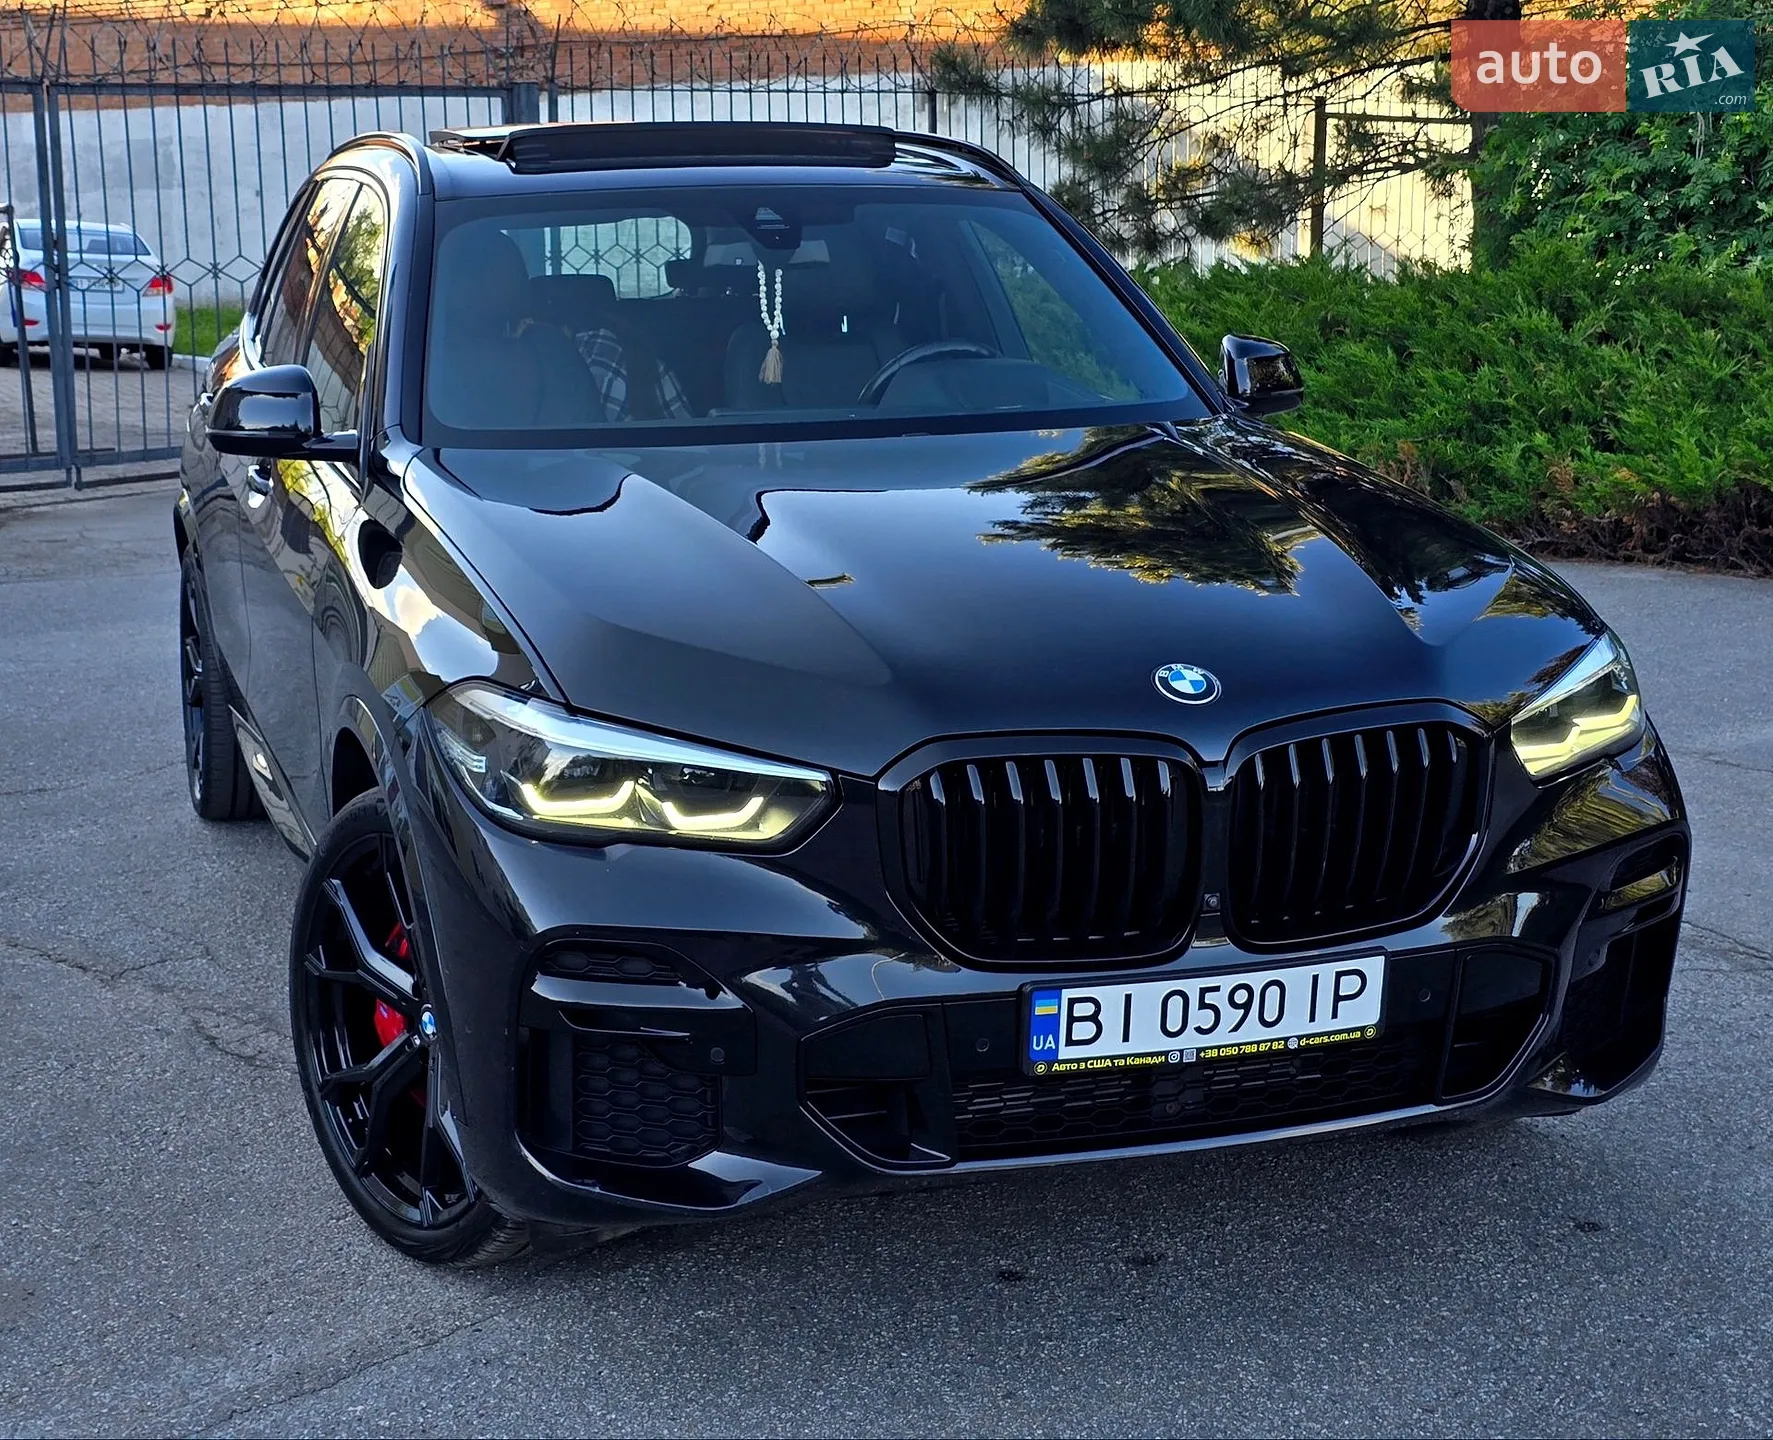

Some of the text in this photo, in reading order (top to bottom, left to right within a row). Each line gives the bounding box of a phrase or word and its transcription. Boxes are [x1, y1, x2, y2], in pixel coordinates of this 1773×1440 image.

[1065, 969, 1367, 1047] BI 0590 IP
[1033, 1034, 1056, 1050] UA
[1199, 1031, 1361, 1059] +38 050 788 87 82 d-cars.com.ua
[1052, 1061, 1077, 1072] Авто
[1087, 1057, 1112, 1069] США
[1113, 1058, 1124, 1067] та
[1127, 1055, 1165, 1066] Канади
